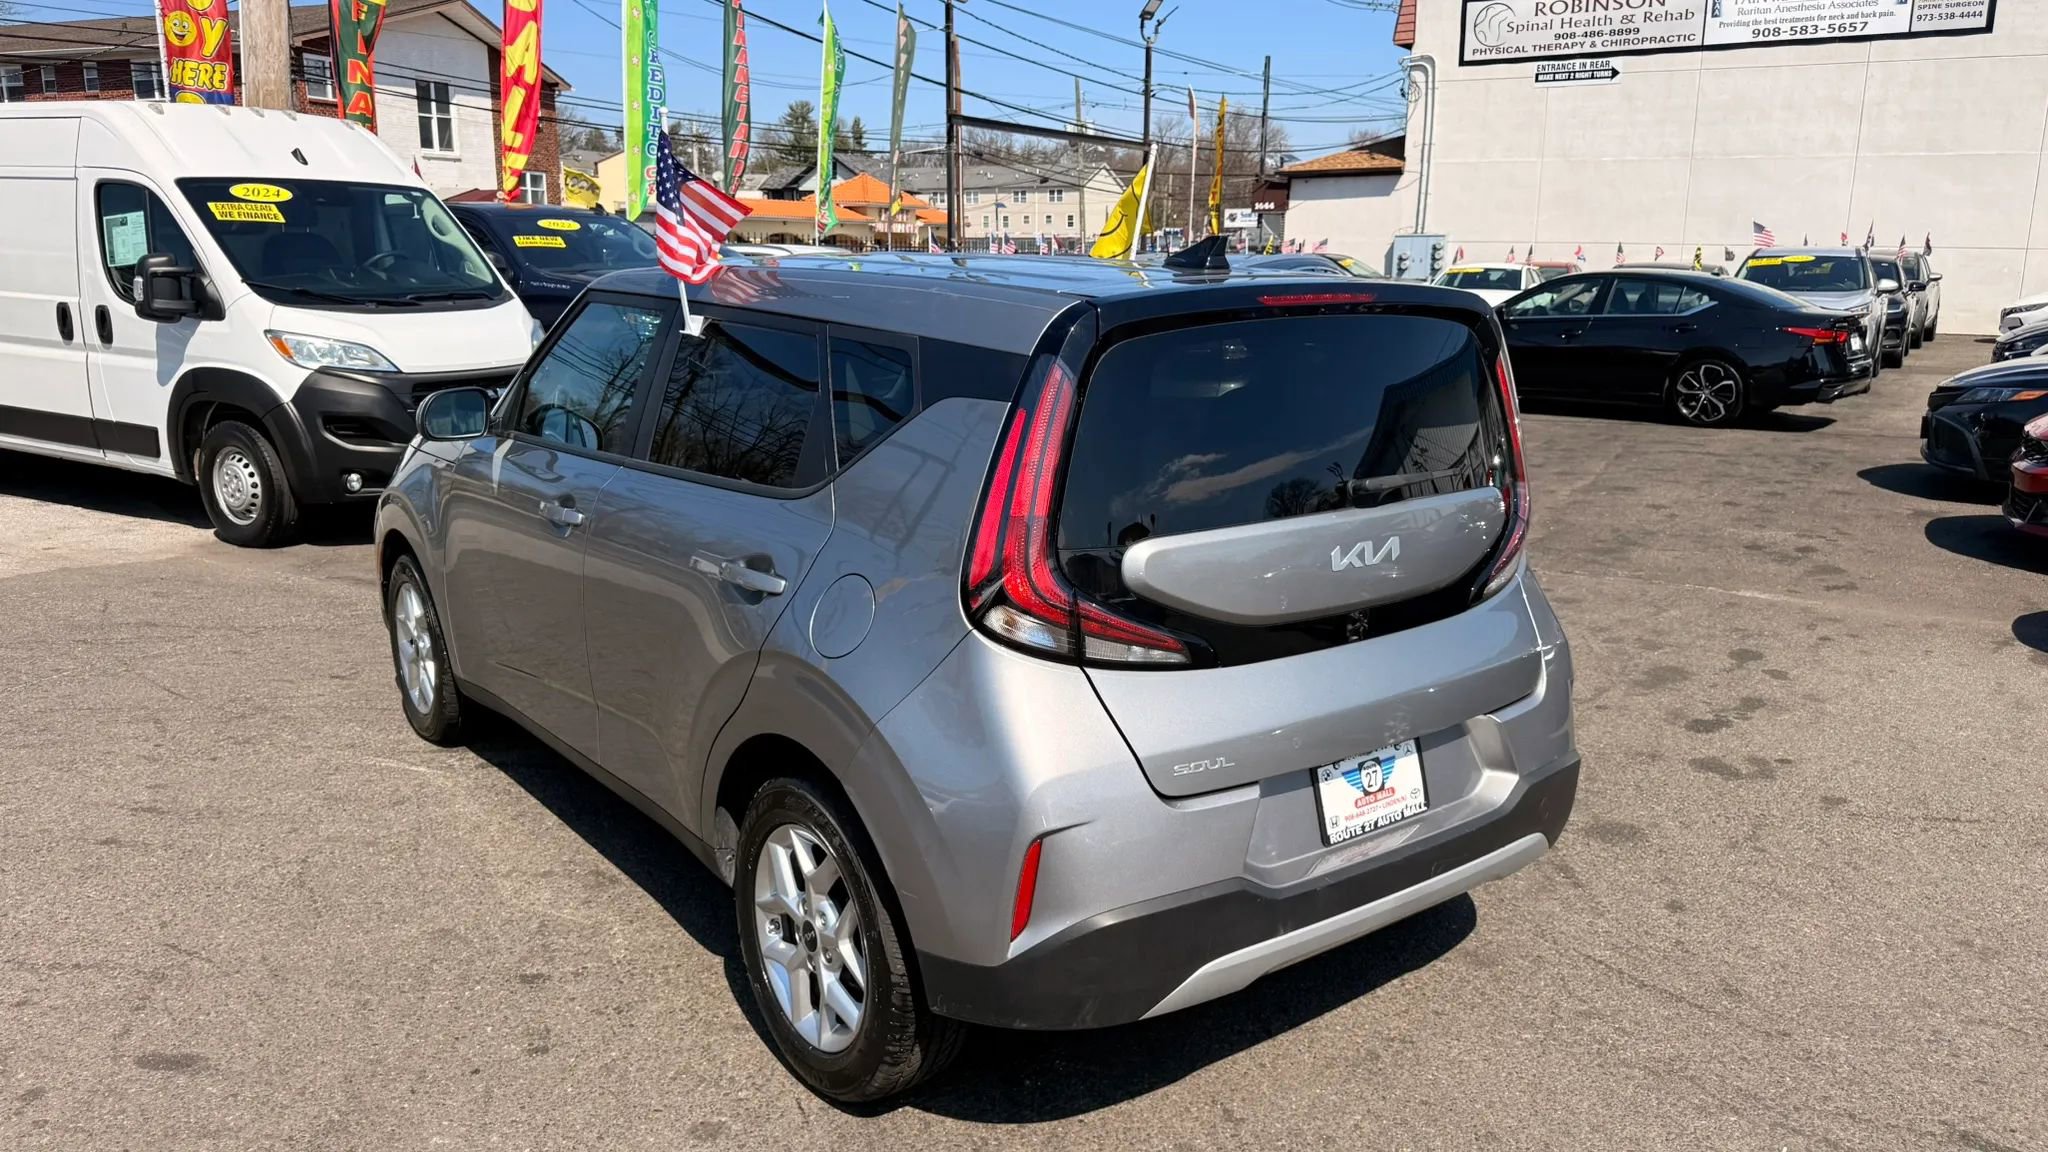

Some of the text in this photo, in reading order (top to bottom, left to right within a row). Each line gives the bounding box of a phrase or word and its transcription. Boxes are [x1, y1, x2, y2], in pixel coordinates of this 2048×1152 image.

[1774, 2, 1826, 13] Anesthesia
[1945, 0, 1985, 9] SURGEON
[1506, 8, 1695, 35] Spinal Health & Rehab
[1718, 19, 1750, 29] Providing
[1751, 18, 1762, 26] the
[1763, 17, 1778, 25] best
[1816, 13, 1827, 22] for
[1828, 12, 1845, 20] neck
[1846, 11, 1859, 20] and
[1860, 10, 1877, 19] back
[1916, 10, 1983, 22] 973-538-4444
[1553, 26, 1640, 41] 908-486-8899
[1751, 21, 1869, 39] 908-583-5657
[1472, 33, 1697, 56] PHYSICAL THERAPY & CHIROPRACTIC
[171, 58, 228, 91] HERE
[1536, 60, 1611, 73] ENTRANCE IN REAR
[1537, 73, 1554, 81] MAKE
[1554, 72, 1570, 80] NEXT
[1574, 71, 1592, 80] RIGHT
[1593, 70, 1613, 78] TURNS
[242, 187, 281, 198] 2024
[217, 210, 281, 221] WE FINANCE
[1331, 536, 1400, 572] KIA
[1173, 757, 1235, 776] SOUL
[1365, 769, 1378, 789] 27
[1329, 822, 1363, 845] ROUTE
[1363, 818, 1376, 833] 27
[1376, 811, 1402, 828] AUTO
